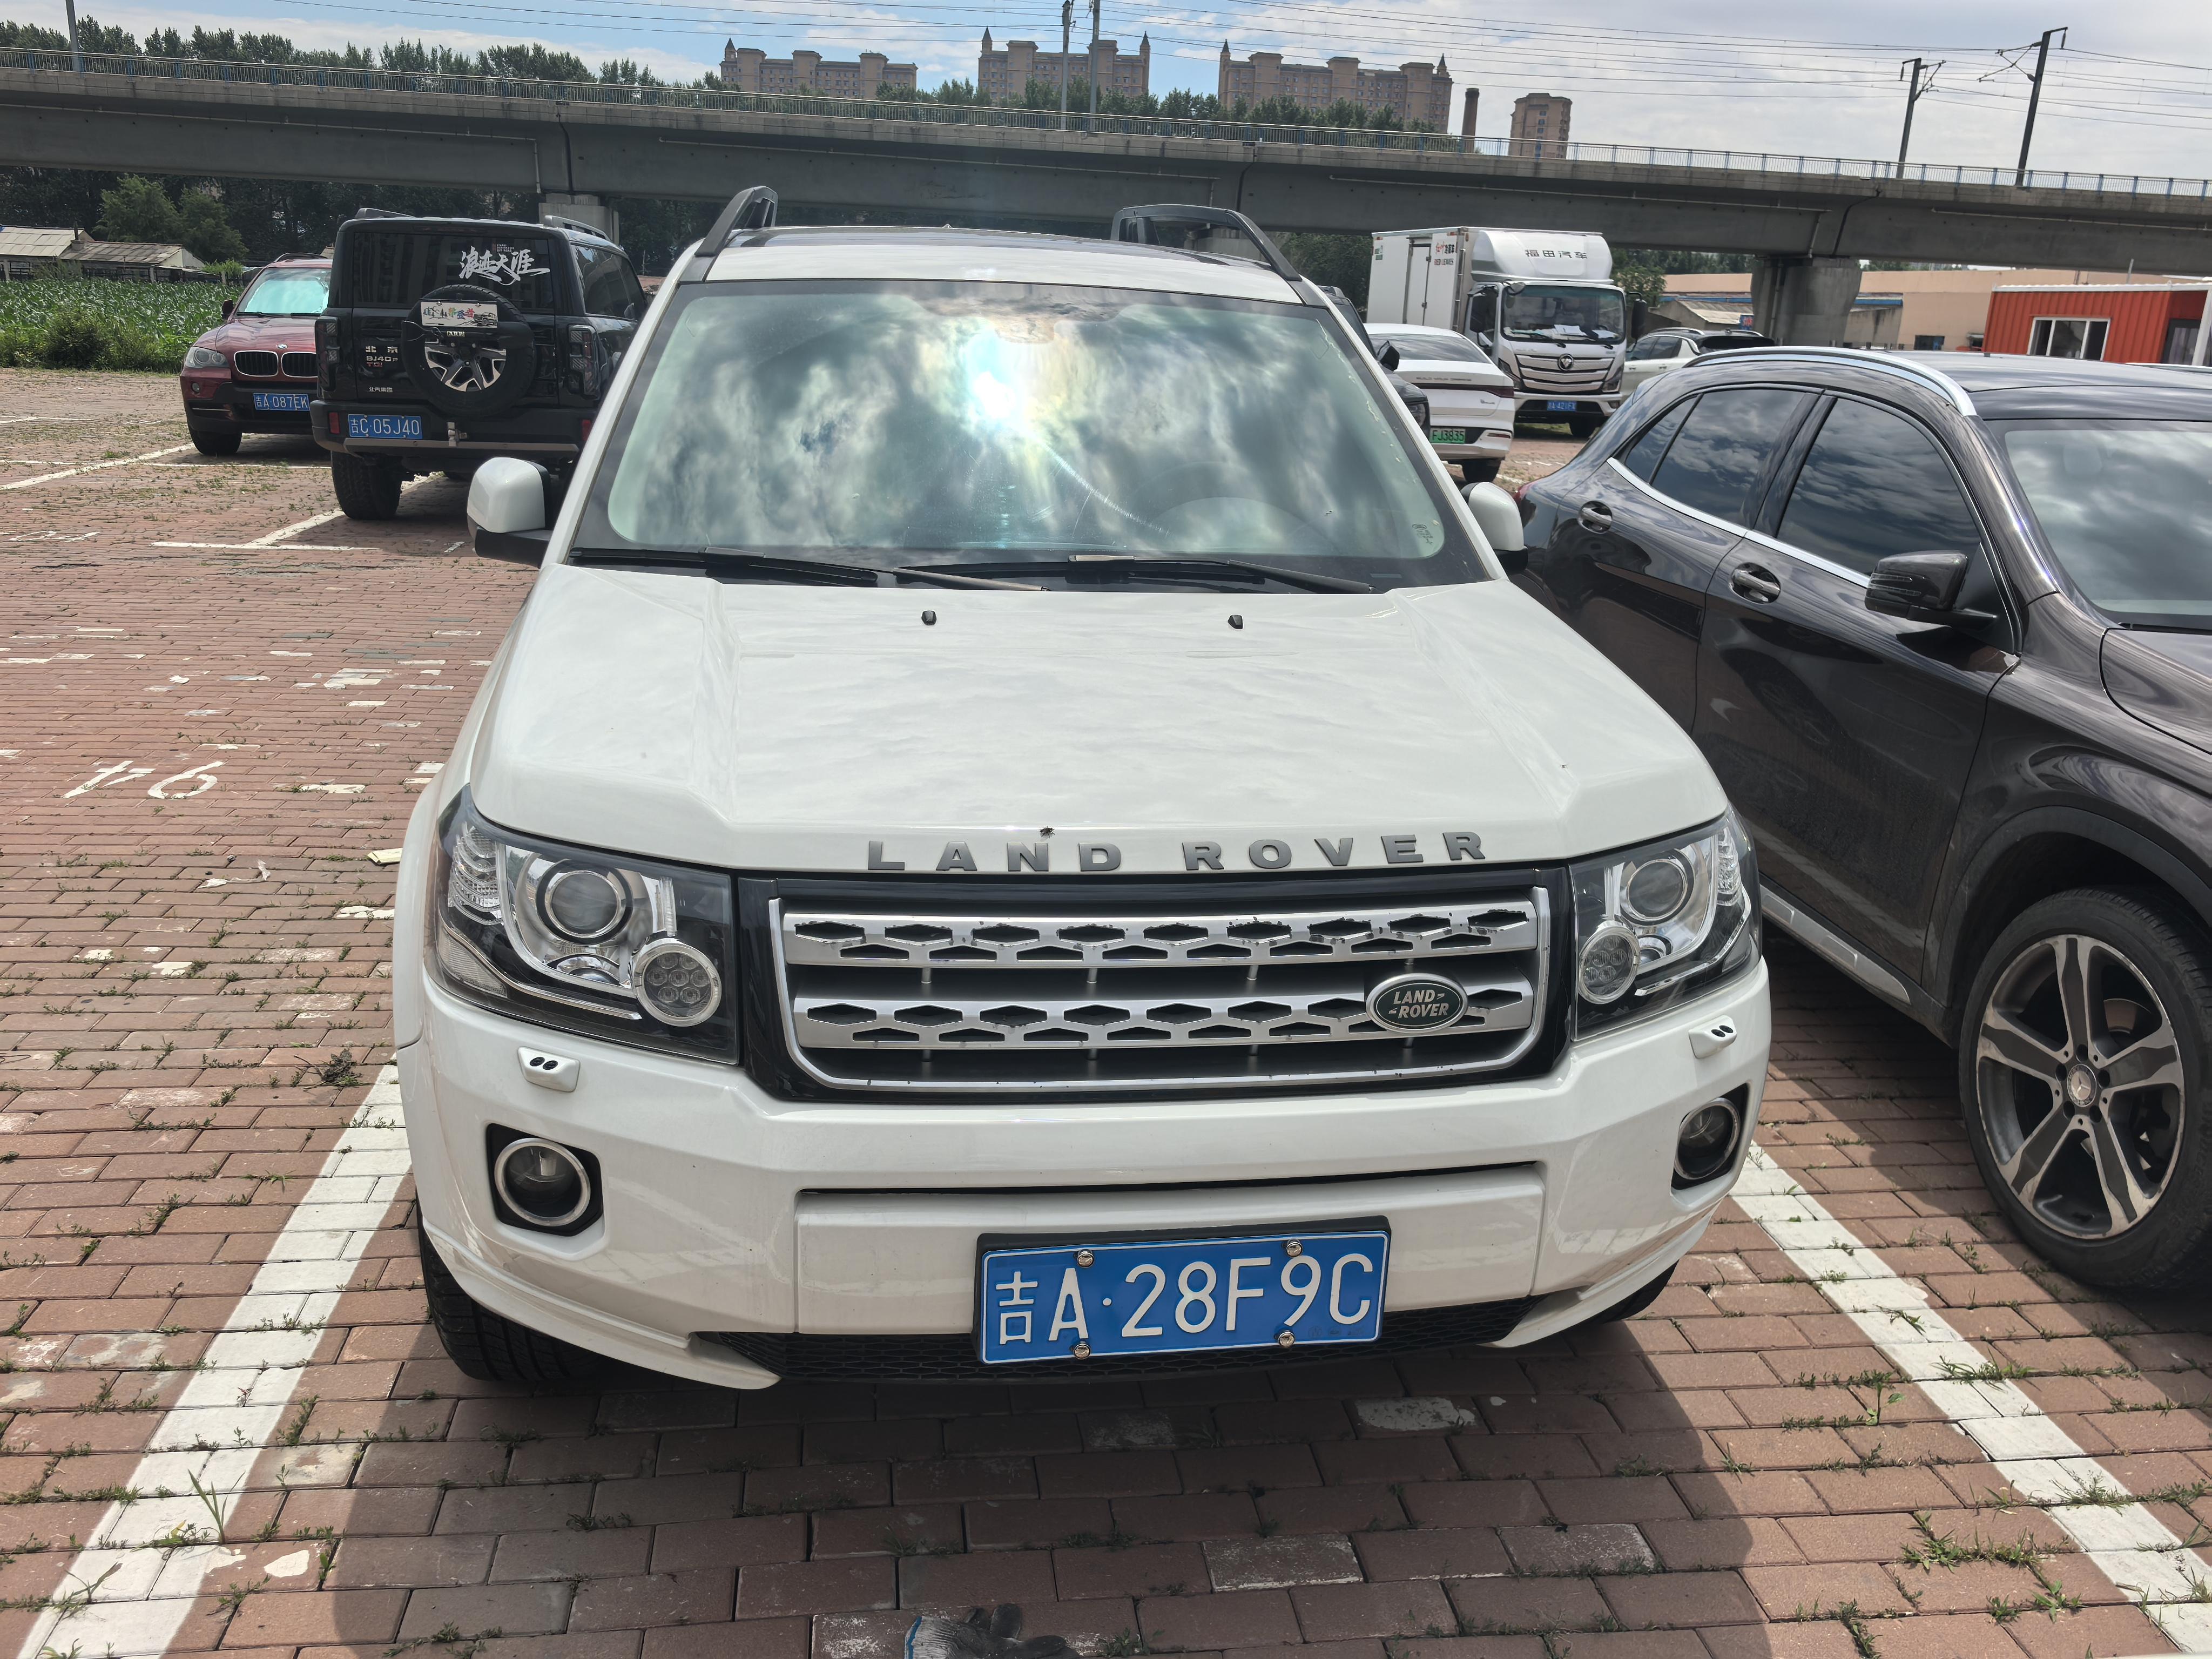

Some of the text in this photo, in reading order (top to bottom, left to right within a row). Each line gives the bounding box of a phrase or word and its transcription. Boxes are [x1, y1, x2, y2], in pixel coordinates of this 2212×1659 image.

[1525, 249, 1588, 259] 福田汽车
[868, 831, 1486, 872] LAND ROVER
